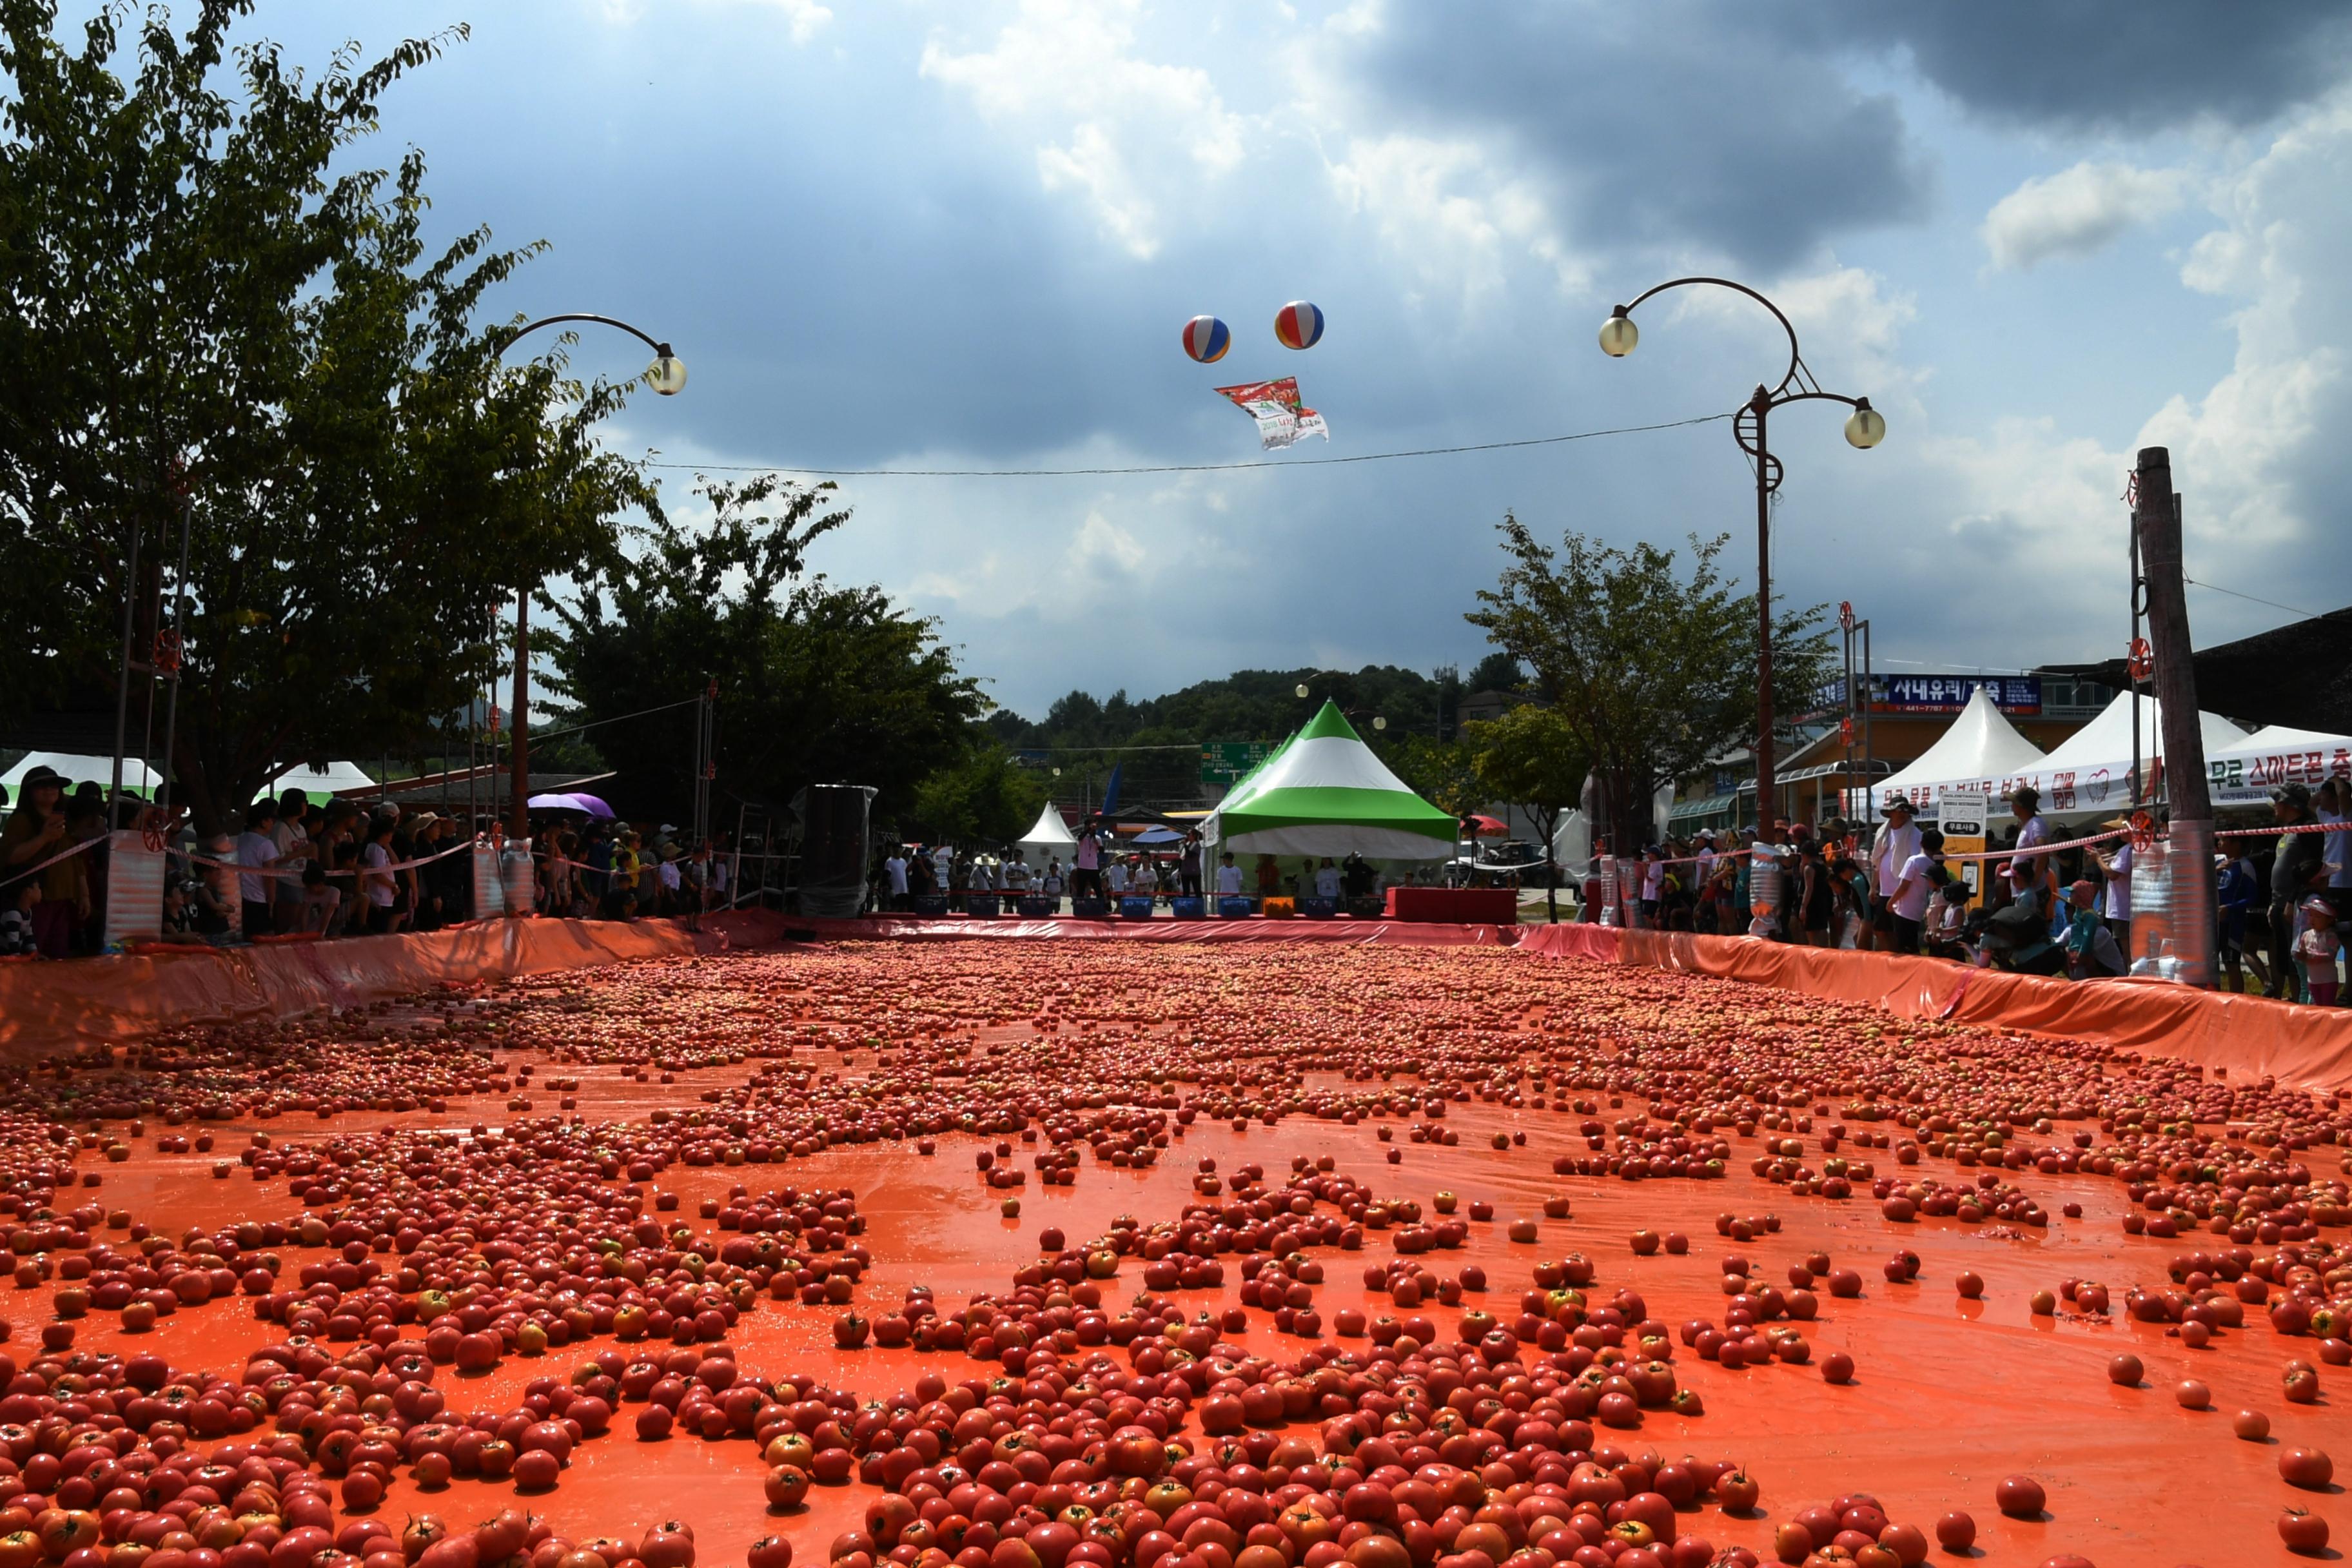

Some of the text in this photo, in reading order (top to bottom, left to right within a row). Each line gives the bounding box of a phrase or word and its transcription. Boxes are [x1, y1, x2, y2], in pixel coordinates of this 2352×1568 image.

[2210, 760, 2243, 790] 무료
[2249, 750, 2324, 787] 스마트폰
[1948, 823, 1975, 831] 무료사용
